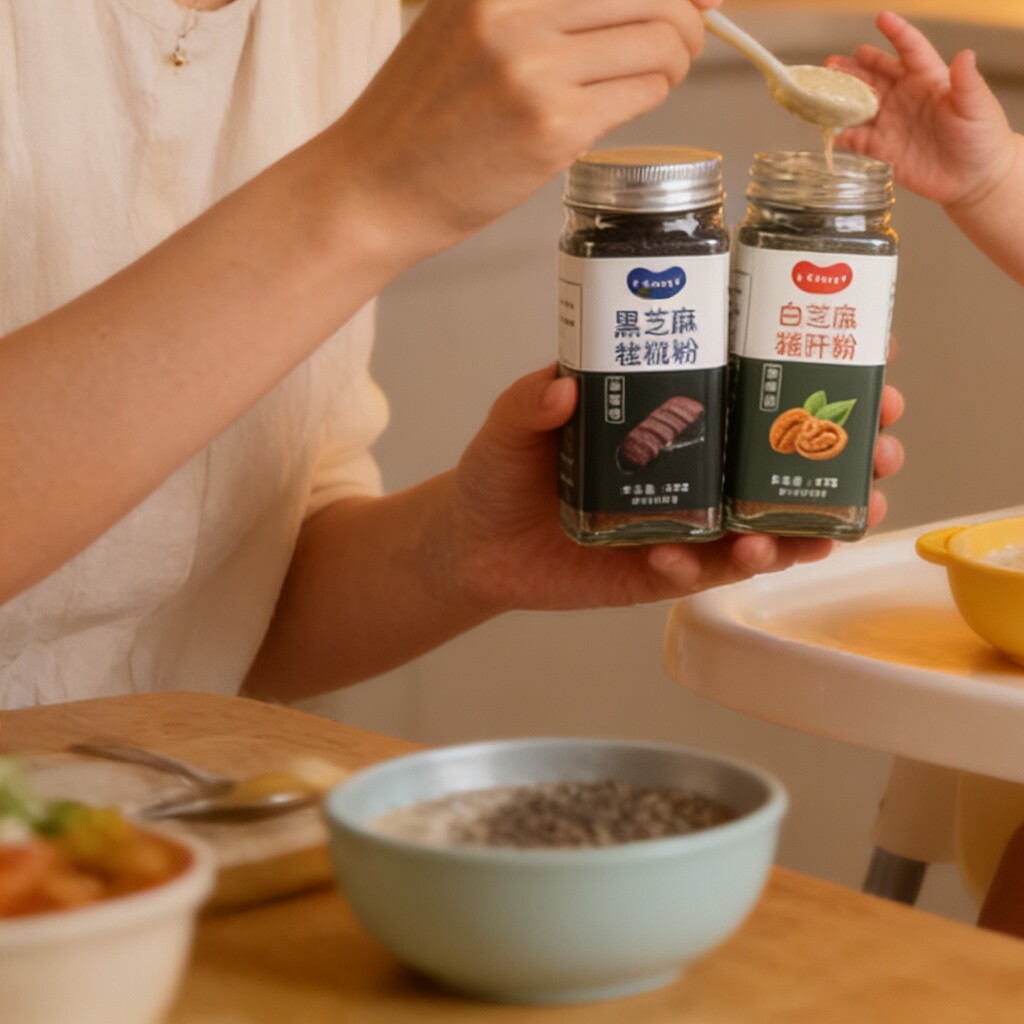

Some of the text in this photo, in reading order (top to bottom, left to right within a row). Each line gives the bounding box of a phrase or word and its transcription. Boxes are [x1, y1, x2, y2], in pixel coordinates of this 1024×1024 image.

[614, 307, 698, 338] 黑芝麻
[779, 301, 858, 330] 白芝麻
